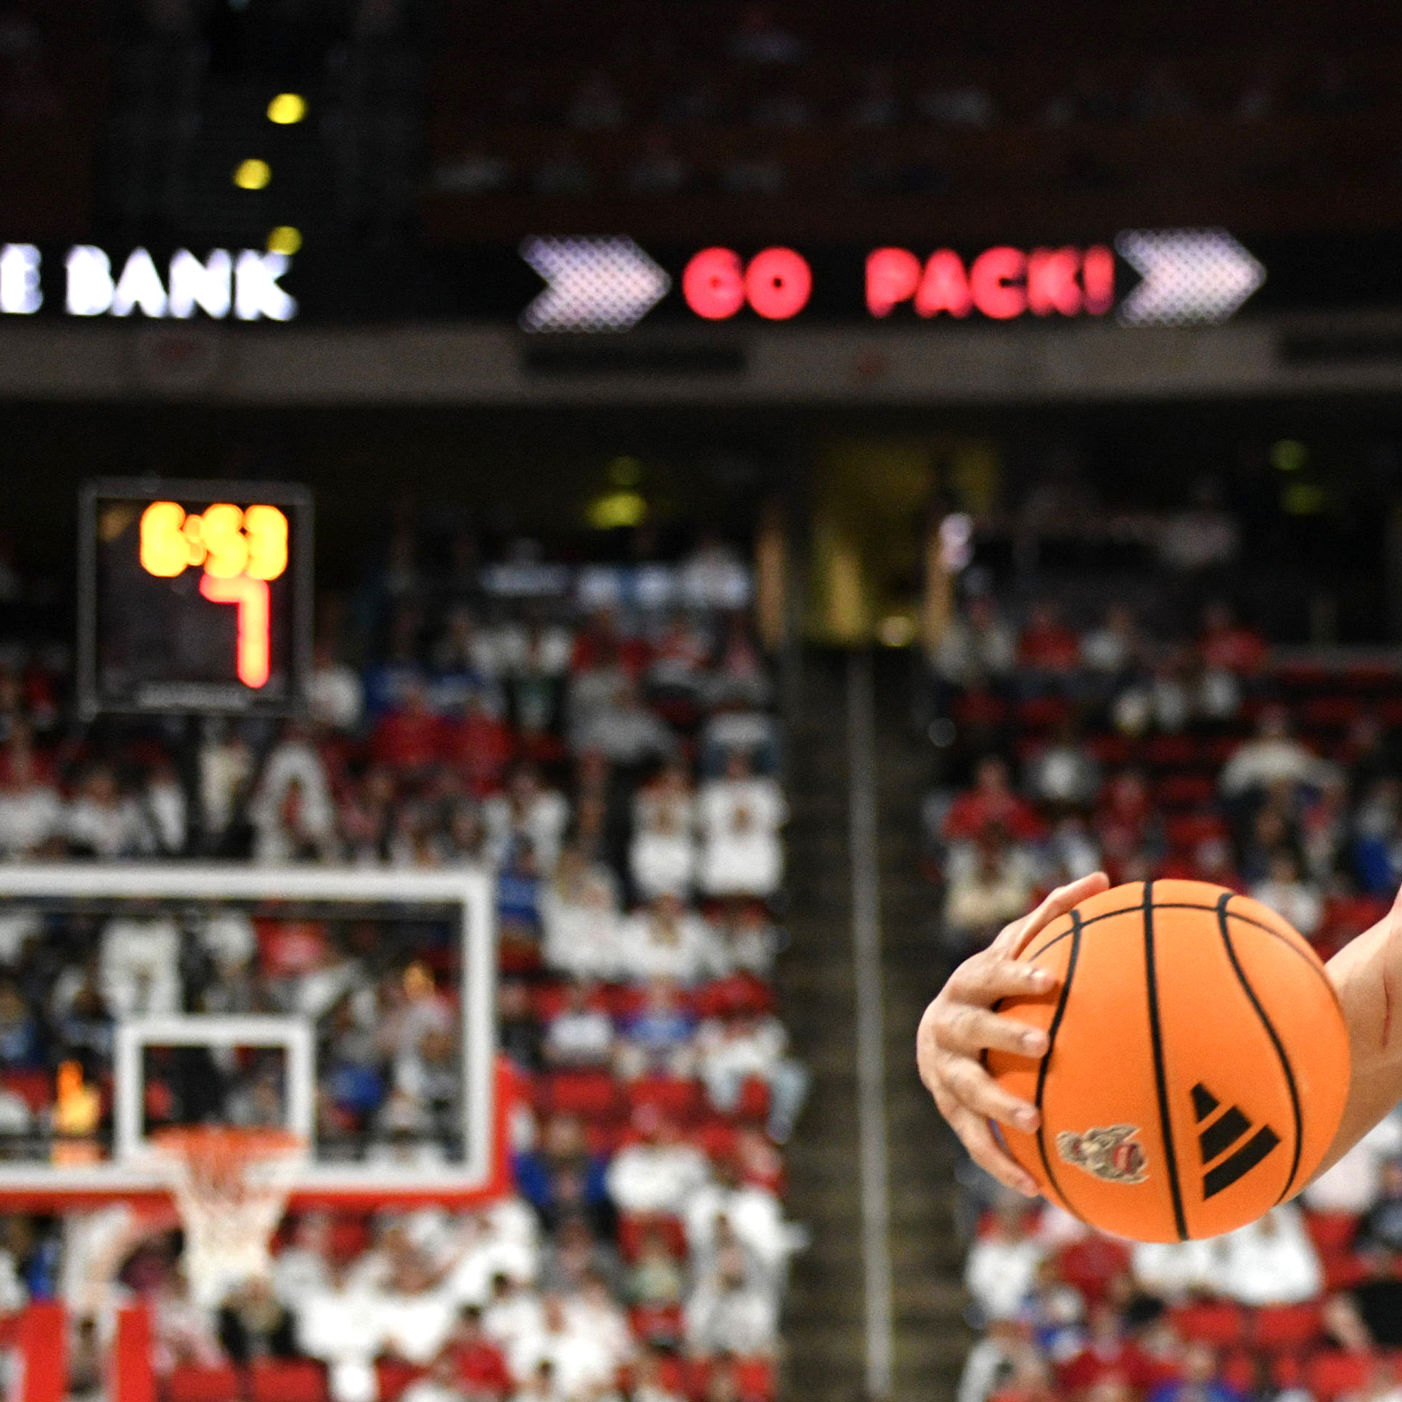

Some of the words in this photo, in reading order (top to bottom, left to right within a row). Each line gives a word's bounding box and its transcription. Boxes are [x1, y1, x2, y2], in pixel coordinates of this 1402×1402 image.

[66, 244, 297, 321] BANK
[682, 246, 812, 319] GO
[865, 245, 1115, 319] PACK!
[200, 574, 270, 688] 7
